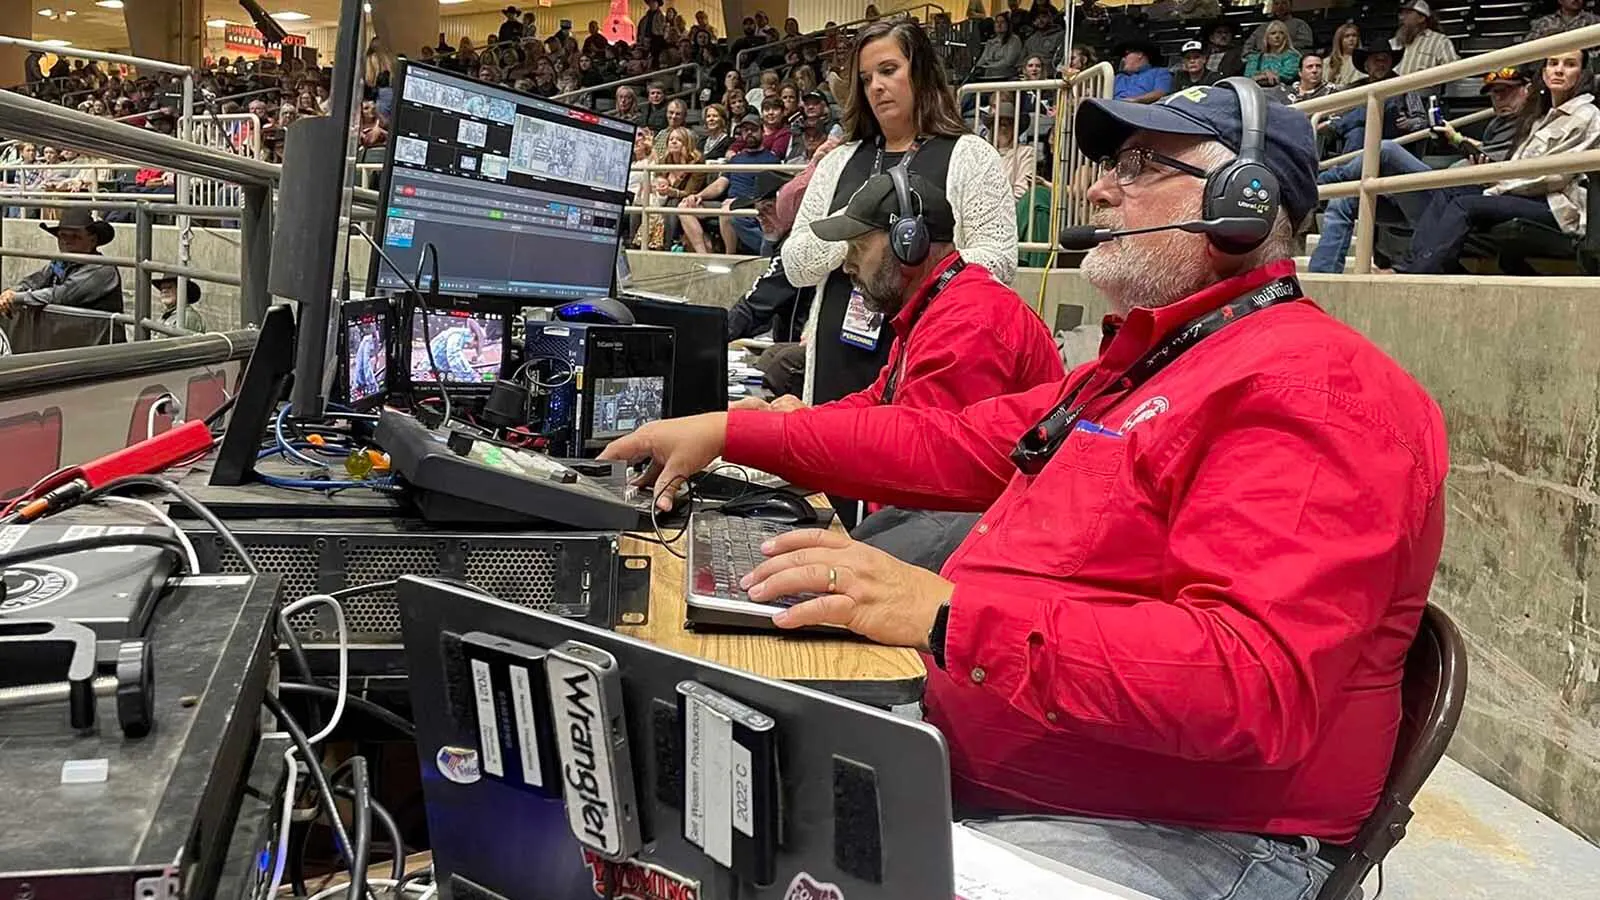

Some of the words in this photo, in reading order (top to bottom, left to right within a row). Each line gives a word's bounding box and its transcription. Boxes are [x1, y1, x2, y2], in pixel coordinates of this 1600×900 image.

[562, 672, 609, 849] Wrangler
[735, 763, 748, 777] C
[735, 780, 749, 823] 2022
